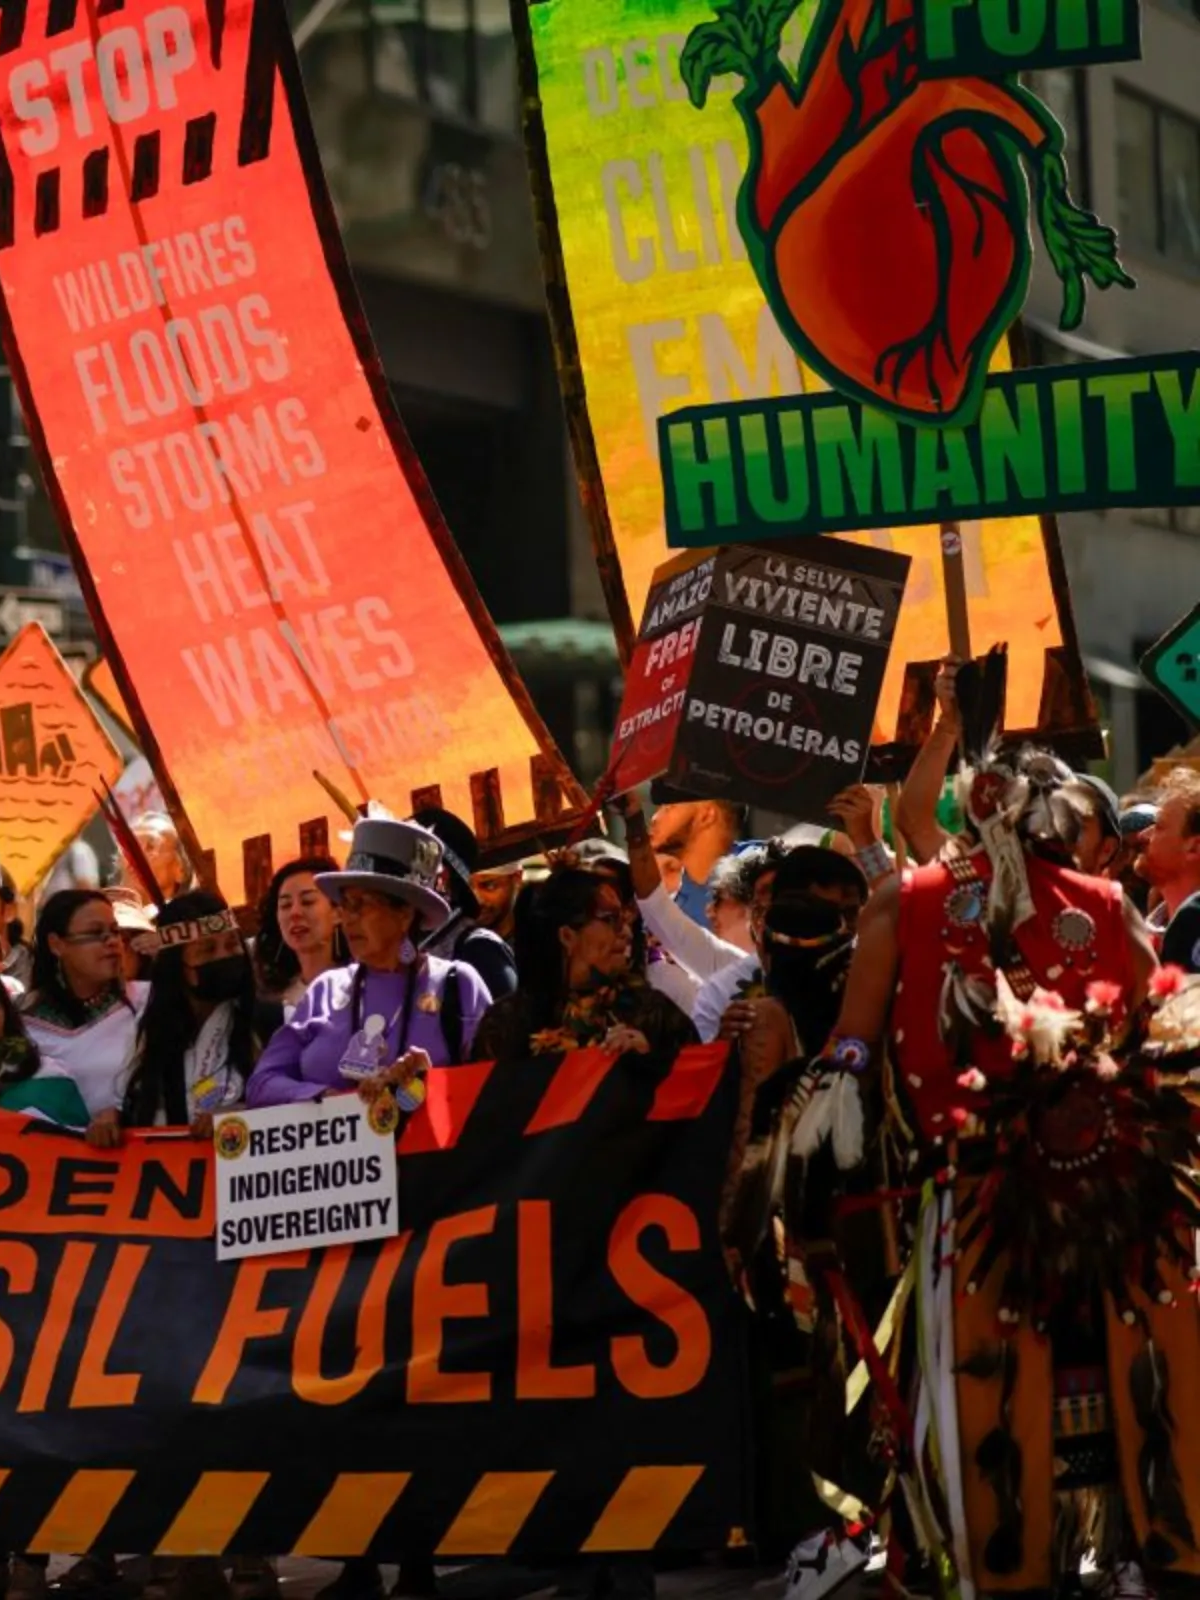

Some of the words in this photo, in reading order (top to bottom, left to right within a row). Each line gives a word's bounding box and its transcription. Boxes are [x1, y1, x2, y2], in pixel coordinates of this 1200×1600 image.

[7, 5, 197, 158] STOP
[602, 139, 748, 284] CLI
[53, 214, 258, 334] WILDFIRES
[73, 293, 290, 436] FLOODS
[109, 397, 326, 529] STORMS
[668, 368, 1200, 532] HUMANITY
[172, 501, 331, 624] HEAT
[764, 557, 786, 578] LA
[793, 565, 854, 595] SELVA
[647, 575, 713, 633] AMAZO
[724, 572, 886, 640] VIVIENTE
[180, 595, 416, 728] WAVES
[716, 623, 863, 697] LIBRE
[618, 690, 687, 740] EXTRACTI
[687, 699, 861, 764] PETROLERAS
[767, 691, 793, 713] DE
[249, 1114, 360, 1157] RESPECT
[230, 1155, 381, 1203] INDIGENOUS
[221, 1197, 392, 1248] SOVEREIGNTY
[191, 1193, 712, 1406] FUELS
